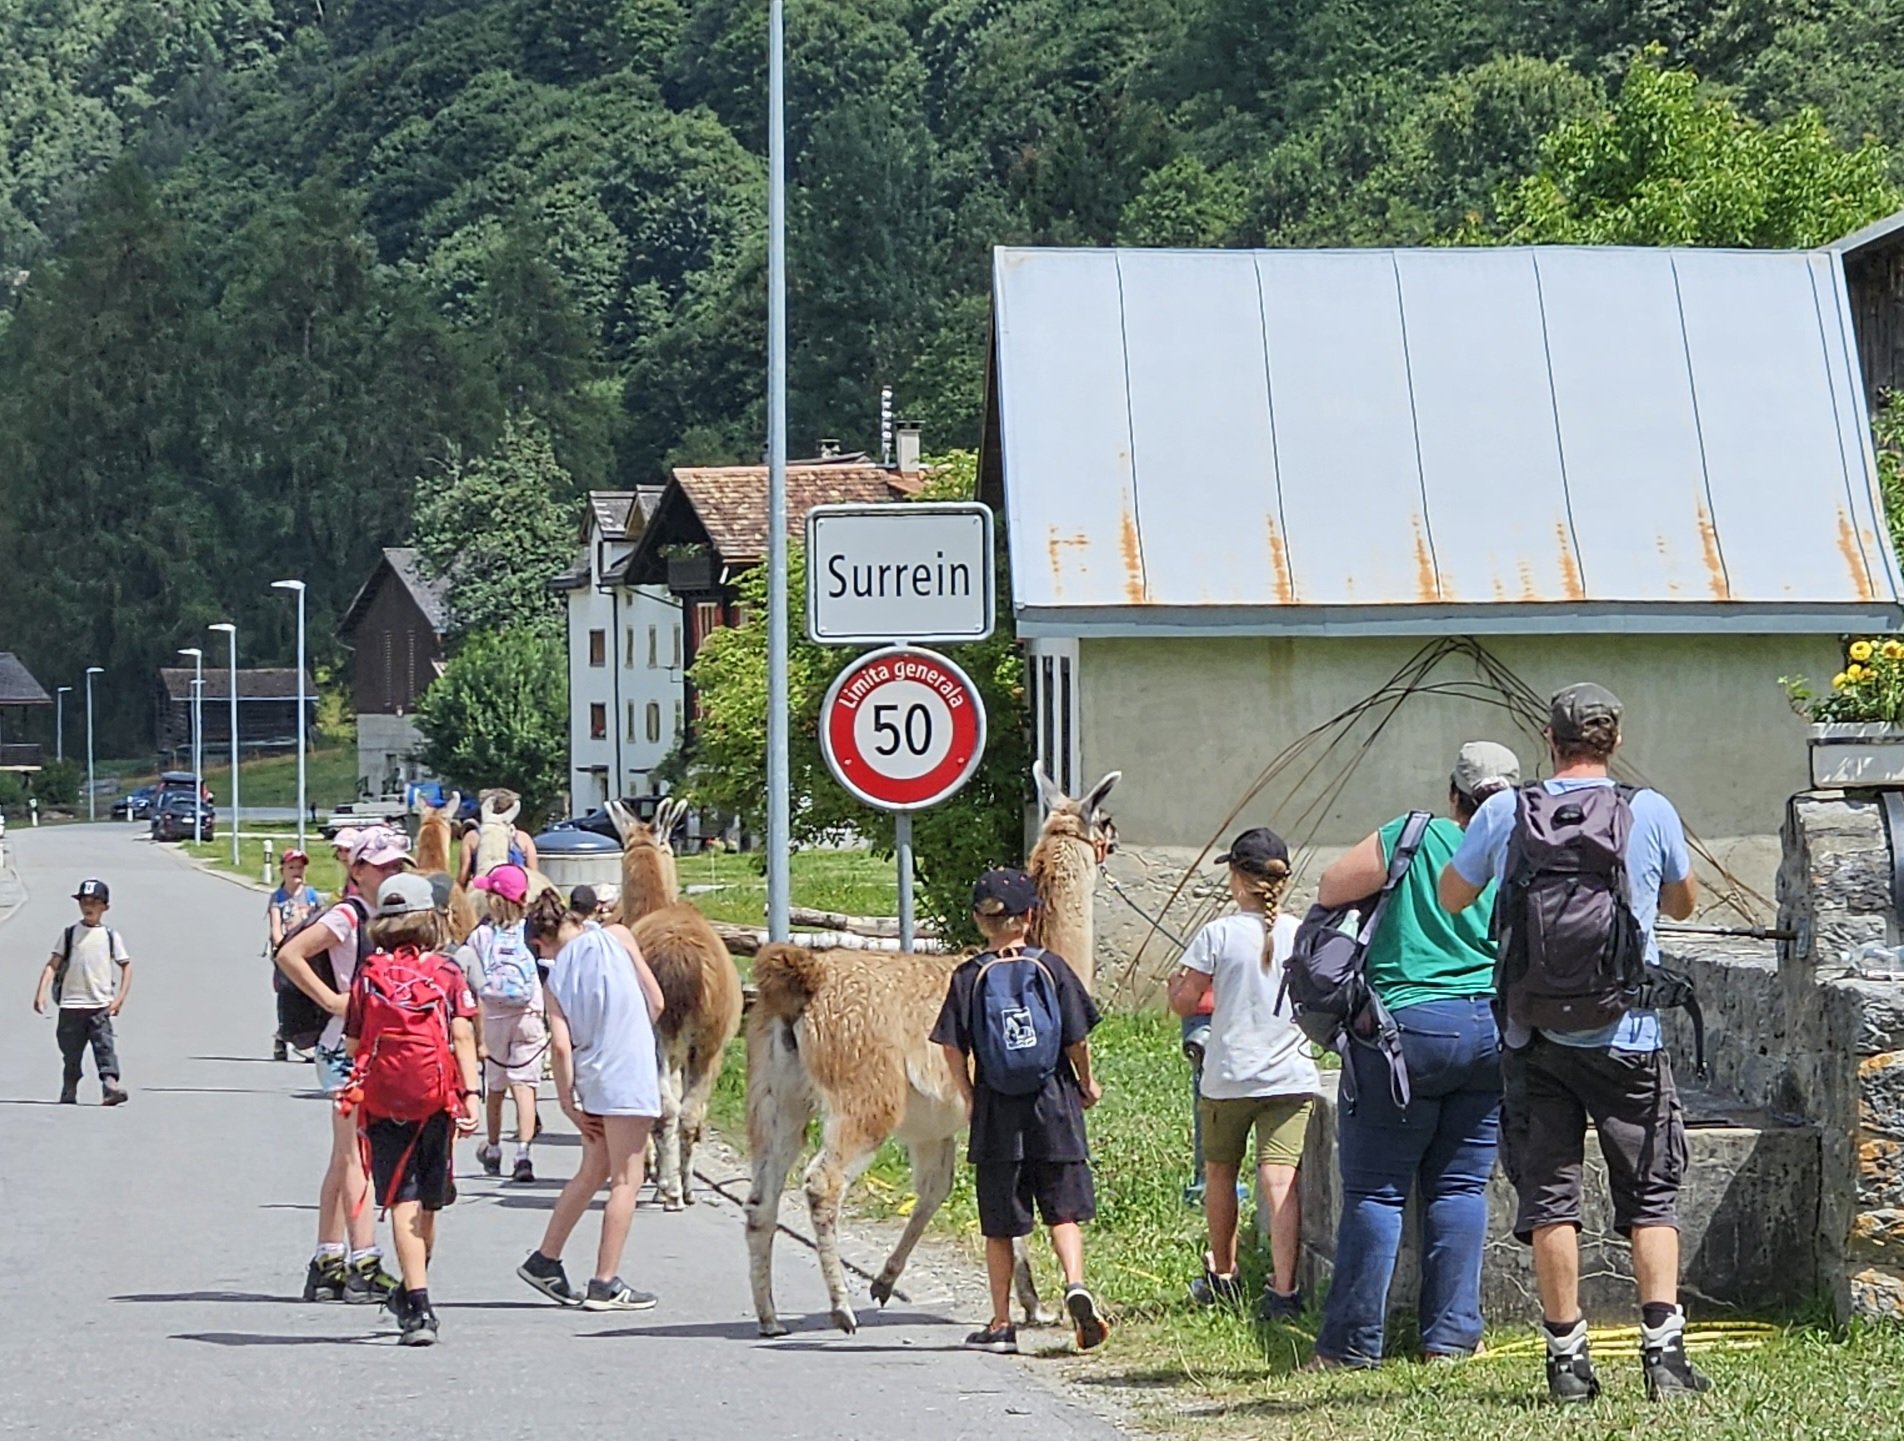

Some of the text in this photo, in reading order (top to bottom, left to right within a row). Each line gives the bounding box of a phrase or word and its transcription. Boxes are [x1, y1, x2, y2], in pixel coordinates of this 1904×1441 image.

[828, 551, 970, 598] Surrein
[838, 661, 964, 710] Limita generala
[873, 703, 933, 756] 50
